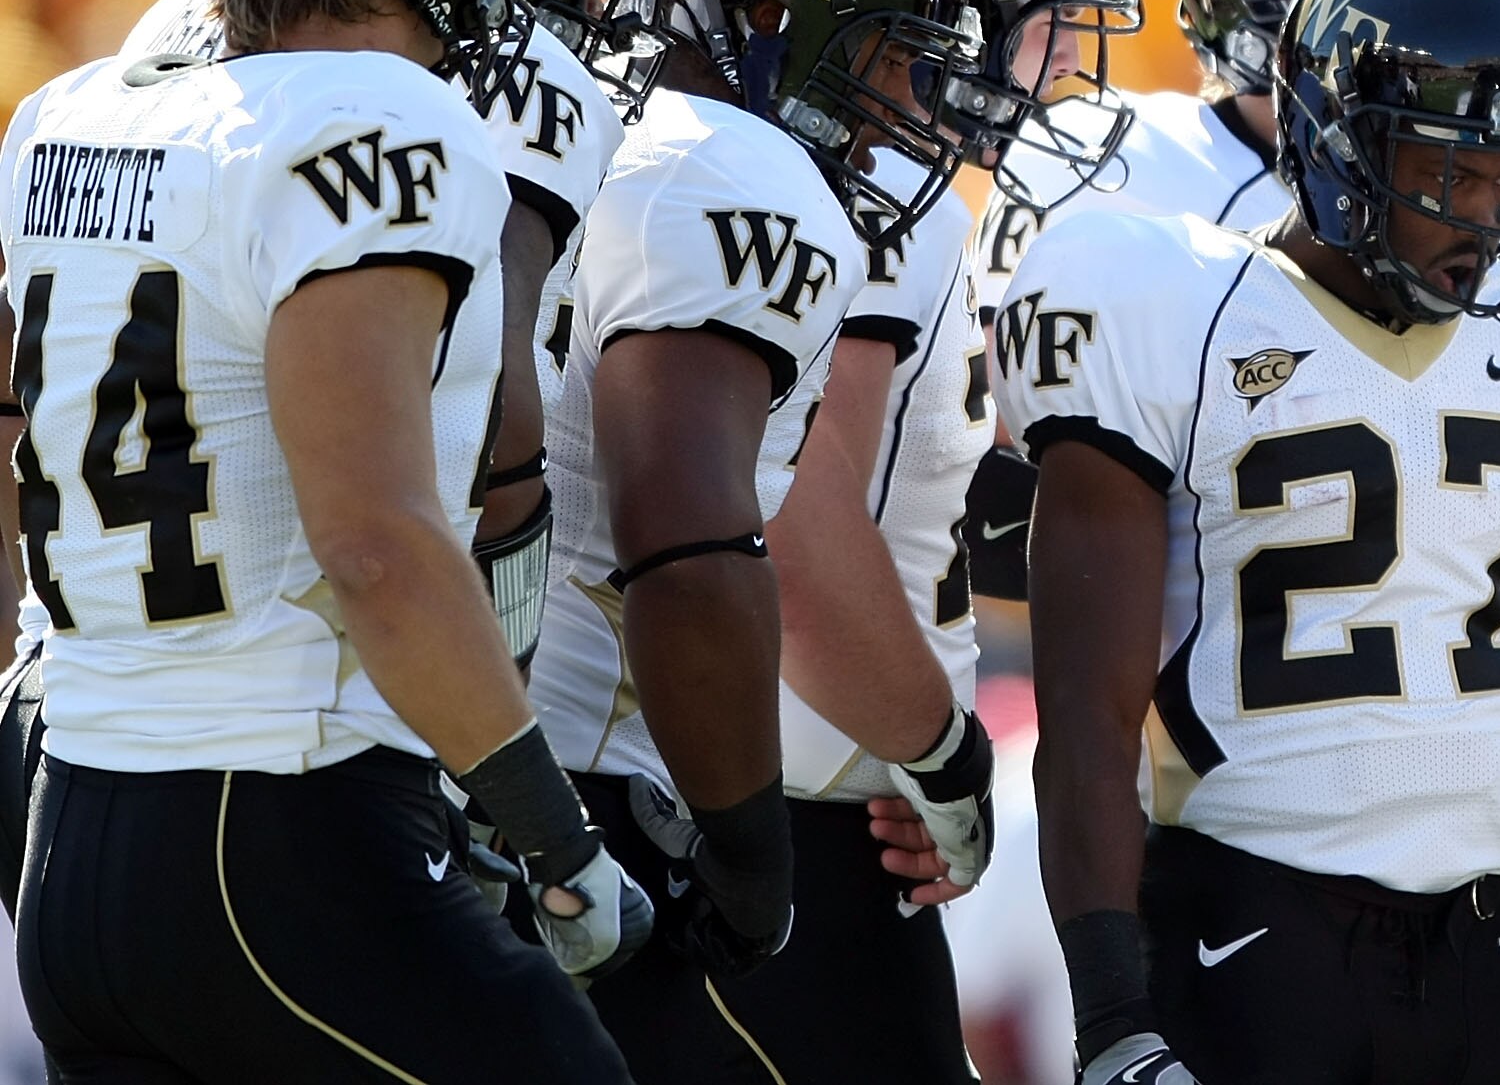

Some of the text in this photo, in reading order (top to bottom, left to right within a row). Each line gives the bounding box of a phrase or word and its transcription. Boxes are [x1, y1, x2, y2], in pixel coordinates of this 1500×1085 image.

[457, 53, 585, 162] WF
[23, 143, 166, 242] RINFRETTE
[290, 127, 449, 228] WF
[704, 208, 836, 323] WF
[996, 288, 1096, 391] WF
[1241, 360, 1288, 388] ACC
